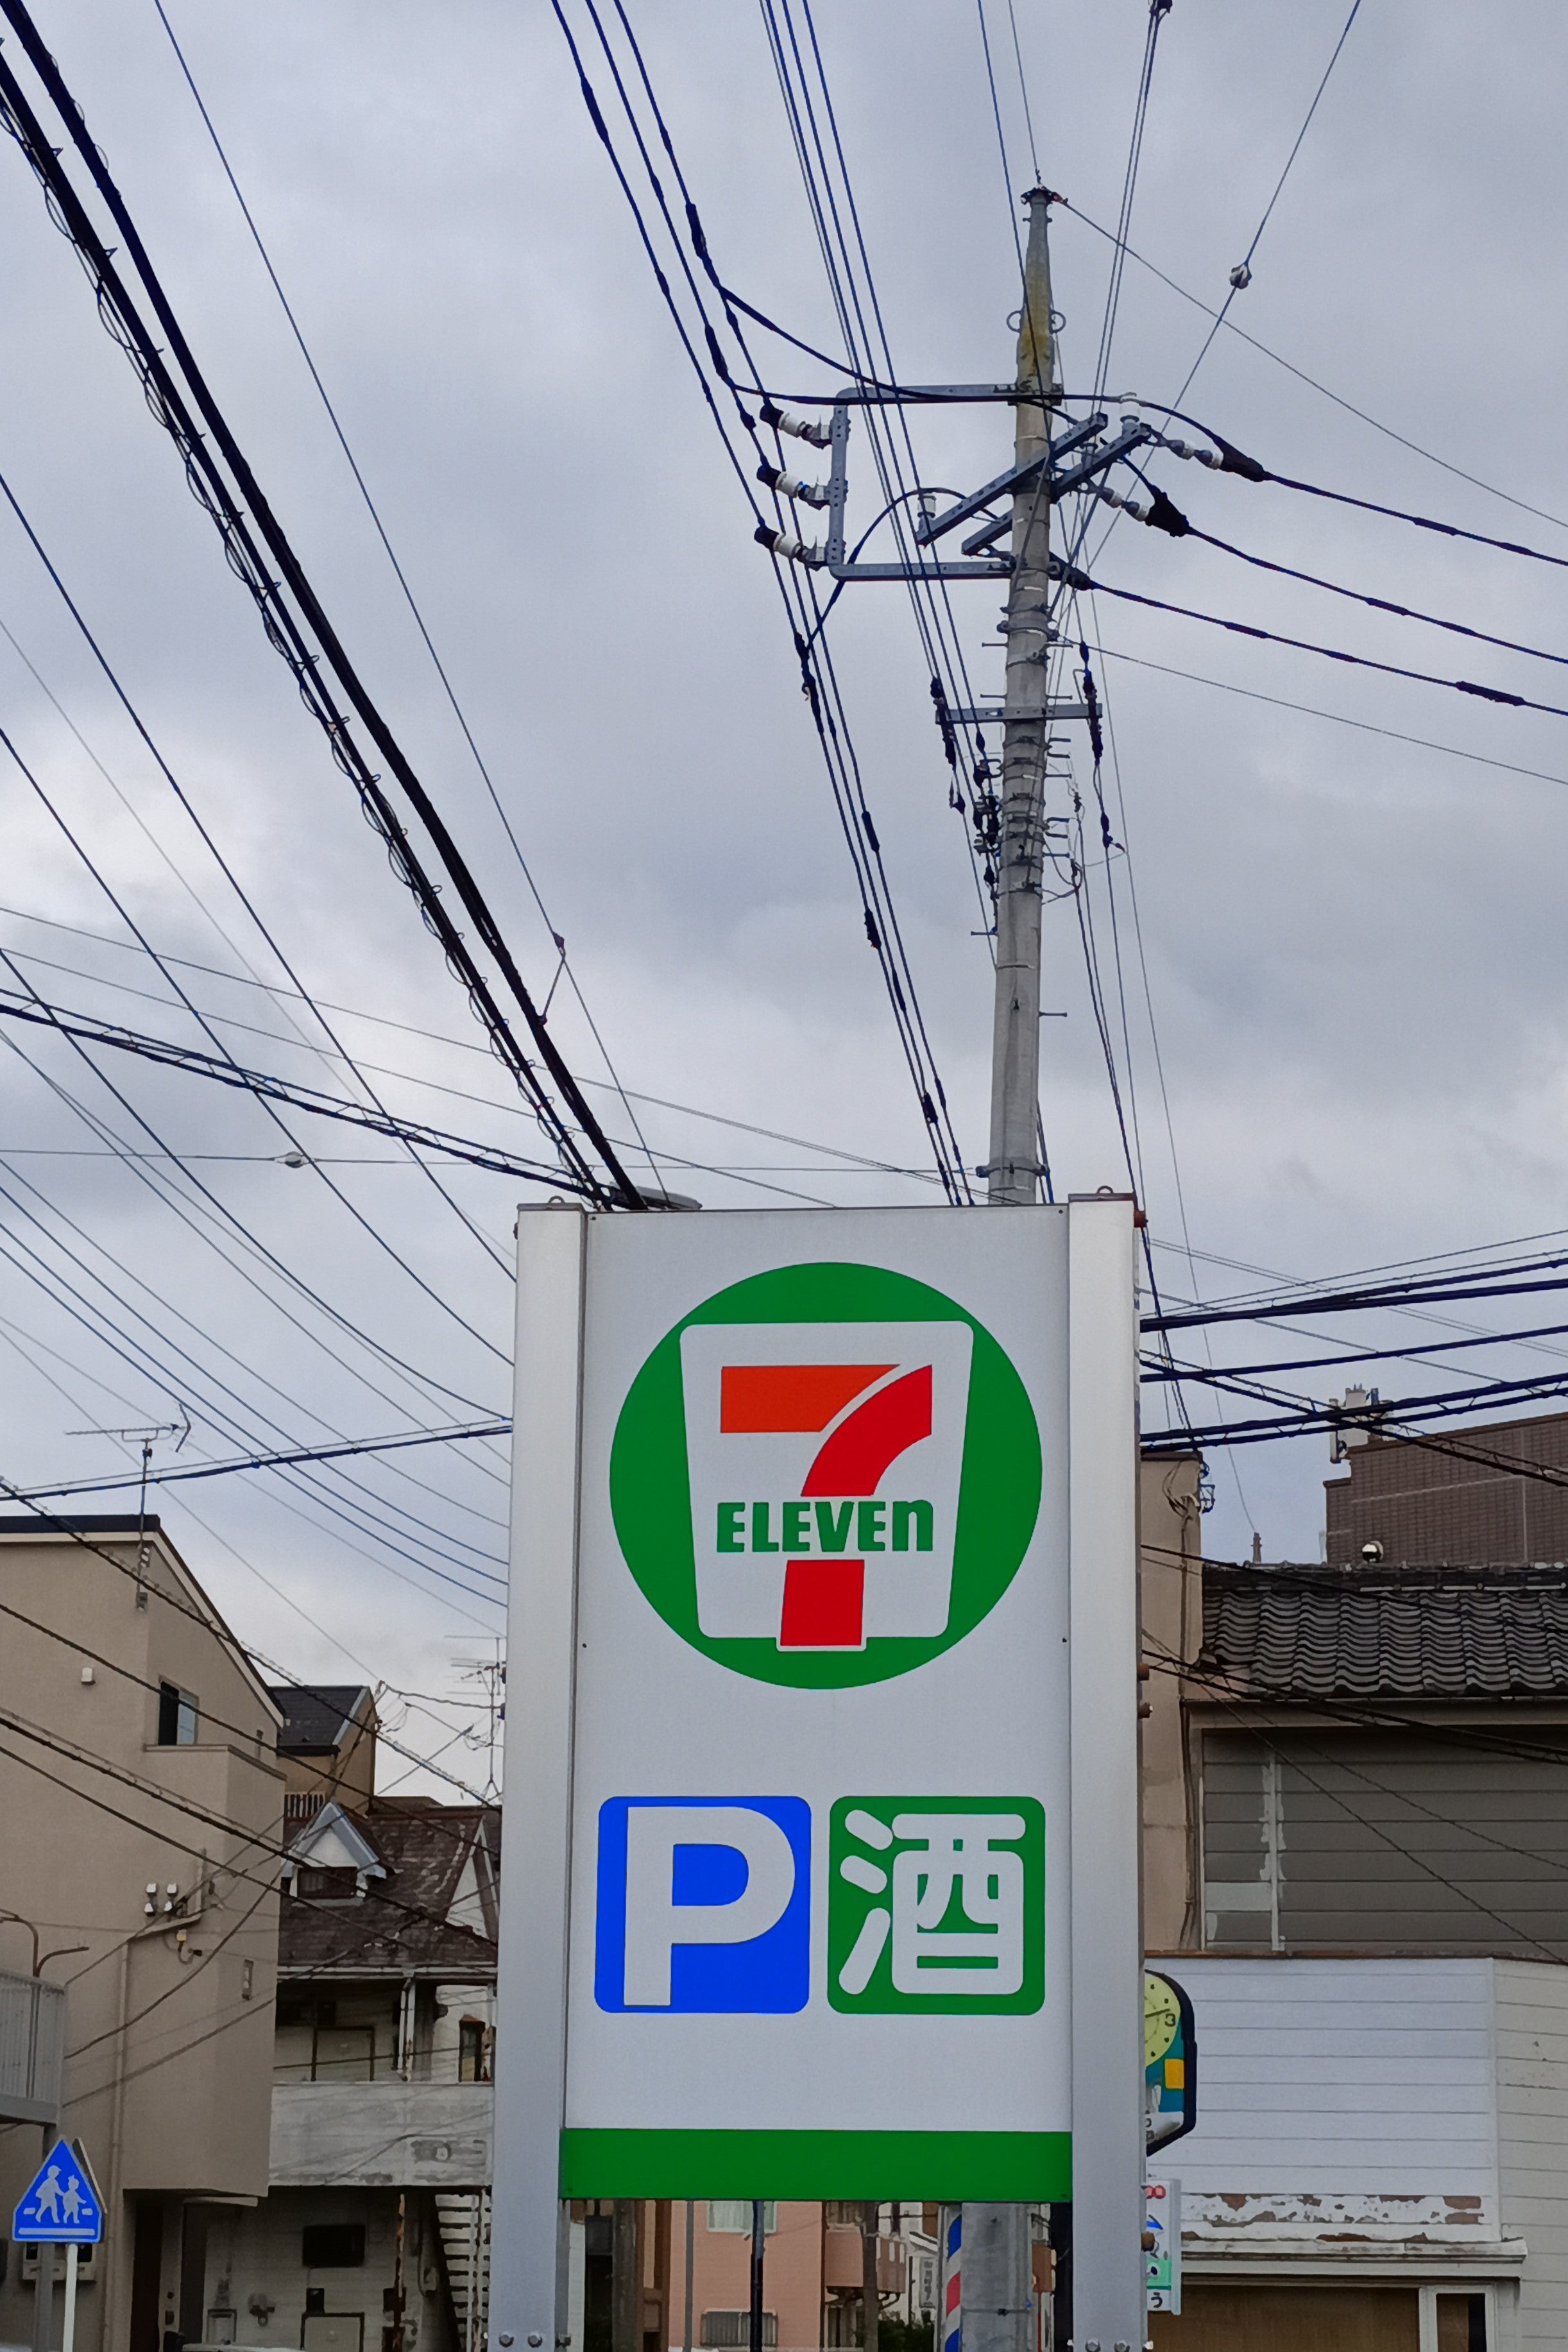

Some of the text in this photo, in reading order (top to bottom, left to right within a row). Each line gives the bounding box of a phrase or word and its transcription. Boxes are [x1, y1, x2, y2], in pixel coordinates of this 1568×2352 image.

[720, 1364, 932, 1646] 7
[623, 1805, 796, 2006] P
[839, 1809, 1026, 1995] 酒
